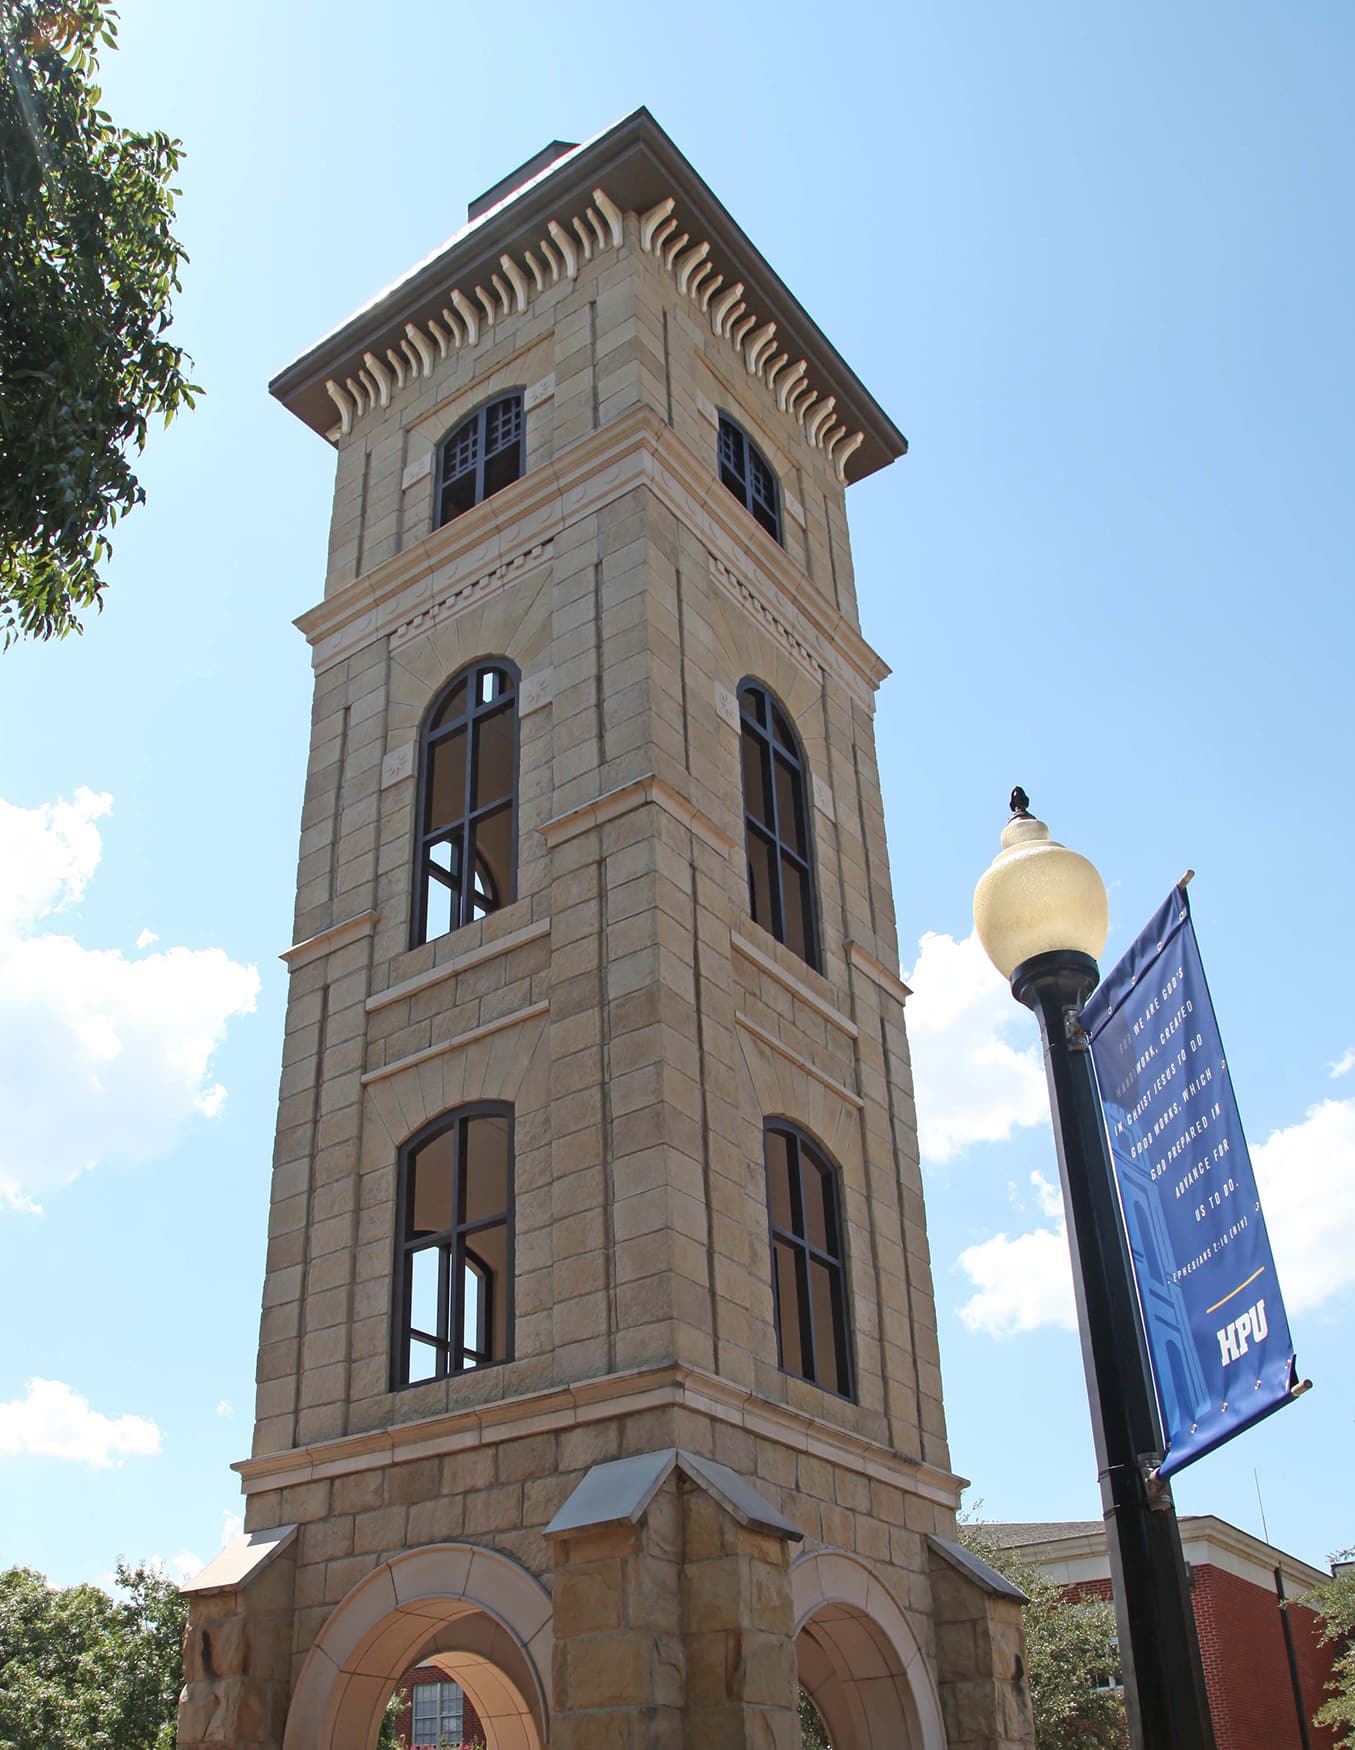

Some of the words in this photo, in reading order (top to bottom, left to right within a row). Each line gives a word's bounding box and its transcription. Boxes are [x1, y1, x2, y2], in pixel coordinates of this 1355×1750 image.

[1119, 1036, 1133, 1054] FOR
[1134, 1018, 1145, 1036] WE
[1146, 998, 1160, 1022] ARE
[1162, 967, 1185, 1001] GOD'S
[1160, 1000, 1193, 1046] CREATED
[1114, 1121, 1124, 1137] IN
[1127, 1092, 1152, 1125] CHRIST
[1153, 1065, 1176, 1096] JESUS
[1177, 1050, 1187, 1067] TO
[1191, 1033, 1203, 1053] DO
[1130, 1131, 1153, 1159] GOOD
[1153, 1102, 1182, 1134] WORKS,
[1183, 1067, 1213, 1103] WHICH
[1150, 1158, 1167, 1181] GOD
[1167, 1116, 1208, 1164] PREPARED
[1212, 1102, 1222, 1121] IN
[1175, 1158, 1211, 1199] ADVANCE
[1213, 1138, 1230, 1161] FOR
[1195, 1203, 1206, 1222] US
[1209, 1191, 1221, 1209] TO
[1224, 1178, 1239, 1199] DO.
[1172, 1248, 1212, 1283] EPHESIANS
[1213, 1234, 1229, 1253] 2:10
[1229, 1216, 1249, 1241] (NIV)
[1216, 1299, 1269, 1367] HPU
